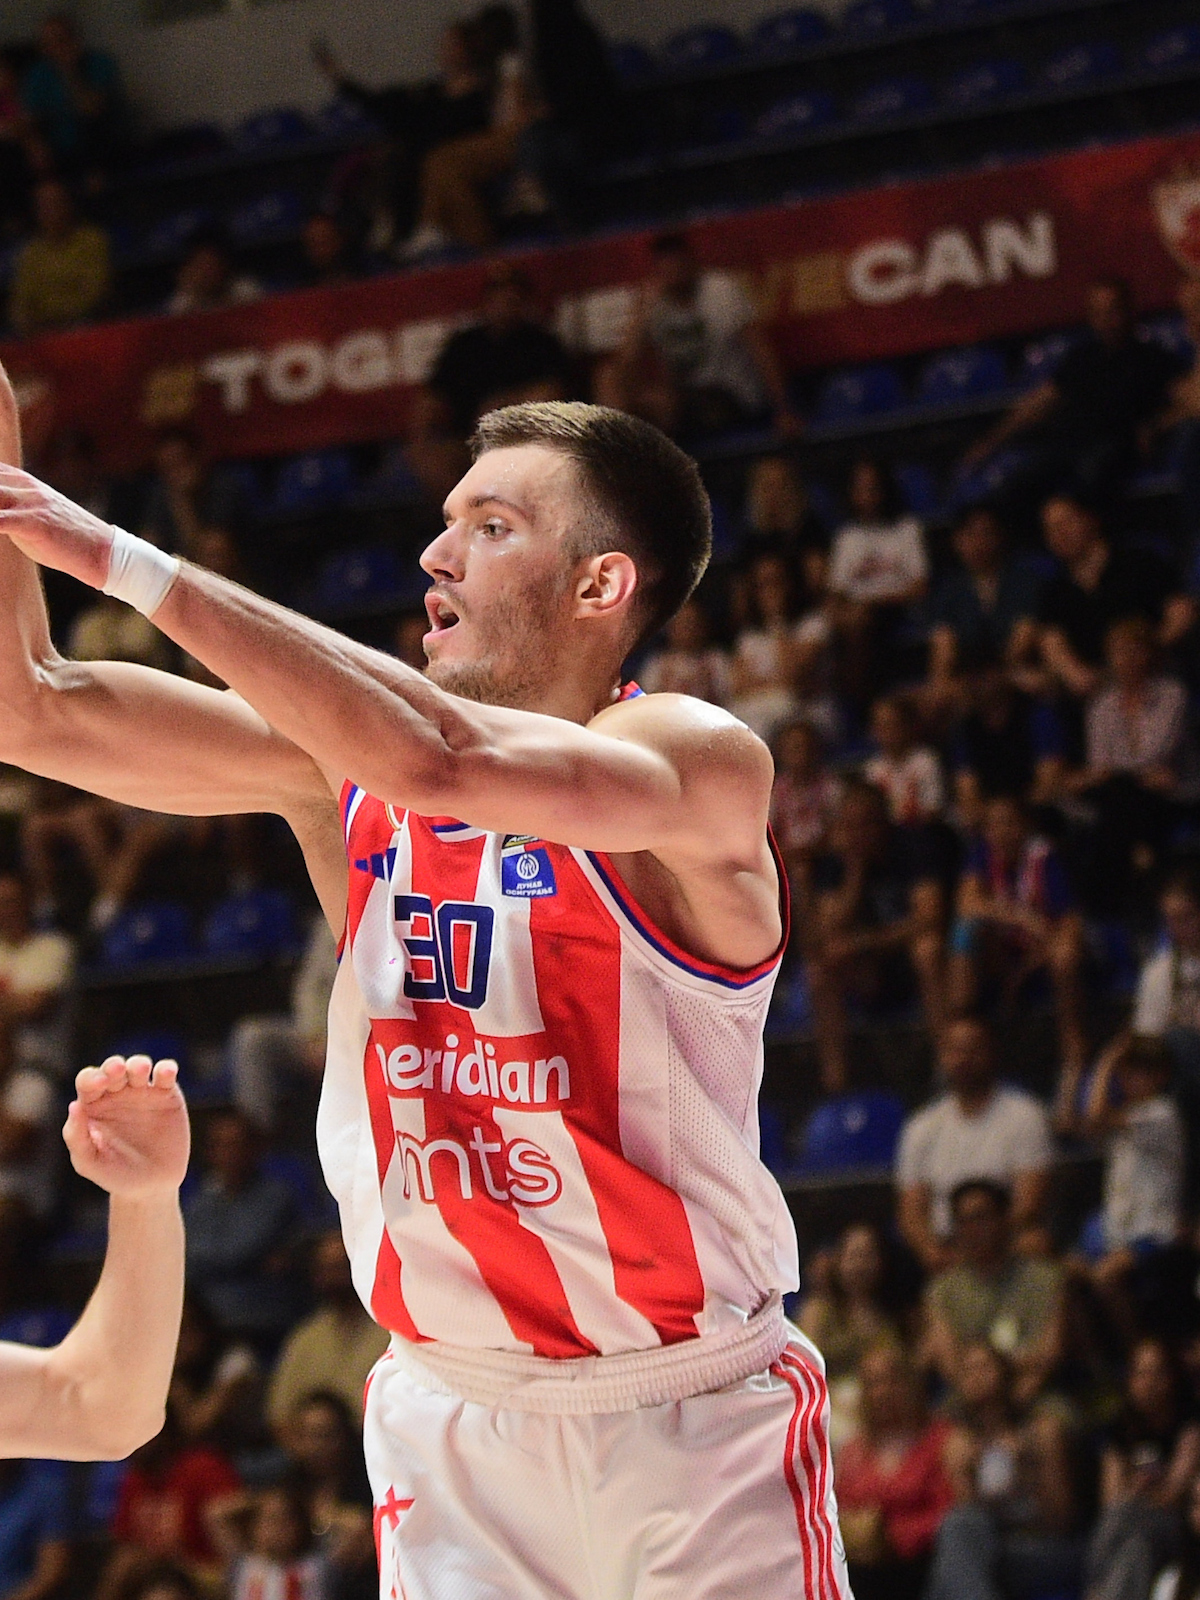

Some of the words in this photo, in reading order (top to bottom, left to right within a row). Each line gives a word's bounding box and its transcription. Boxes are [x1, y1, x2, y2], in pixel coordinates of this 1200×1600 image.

[516, 880, 543, 890] ДУНАВ
[394, 894, 495, 1012] 30
[397, 1127, 563, 1208] mts
